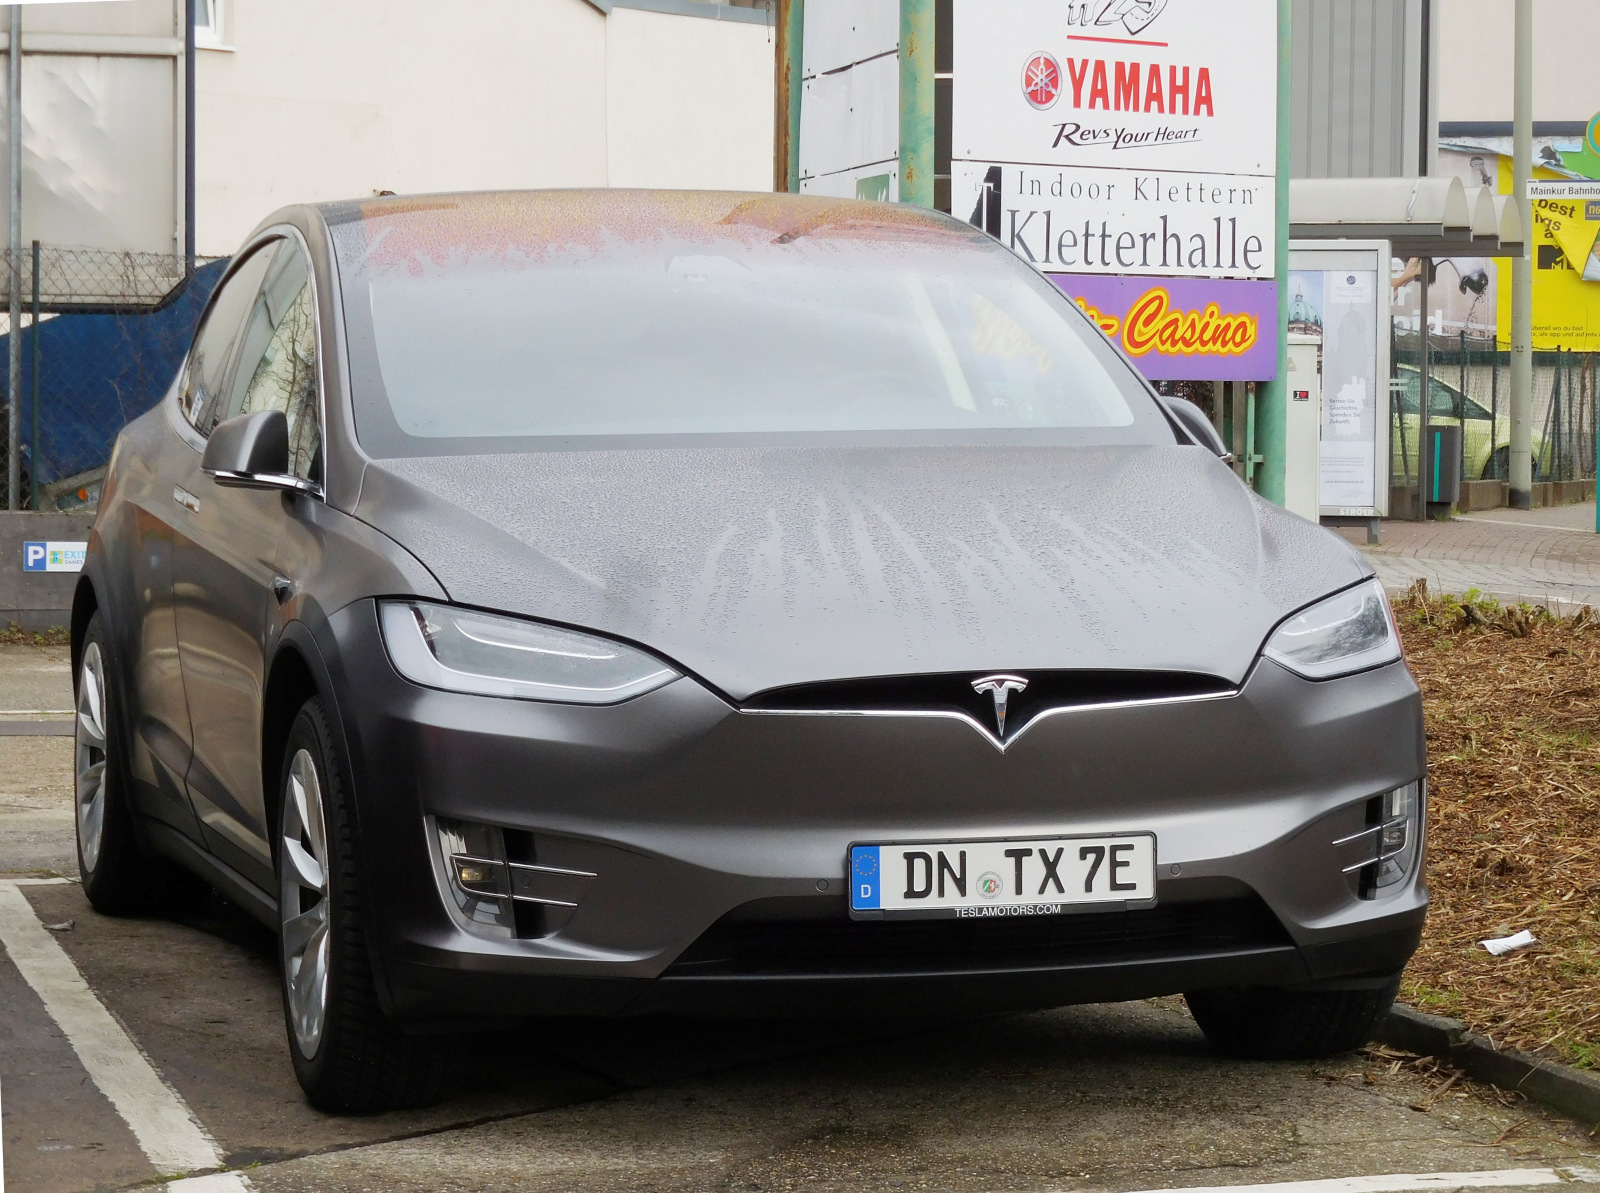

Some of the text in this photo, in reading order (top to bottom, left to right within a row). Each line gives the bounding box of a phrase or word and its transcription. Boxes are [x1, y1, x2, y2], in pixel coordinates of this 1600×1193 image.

[1067, 58, 1214, 117] YAMAHA
[1052, 122, 1201, 150] Revs Your Heart
[1018, 170, 1253, 204] Indoor Klettern
[1531, 187, 1565, 195] Mainkur
[1006, 209, 1263, 271] Kletterhalle
[1124, 290, 1256, 354] Casino
[28, 545, 45, 567] P
[64, 550, 86, 559] EXIT
[903, 850, 967, 899] DN
[1004, 847, 1065, 895] TX
[1079, 843, 1137, 893] 7E
[860, 884, 872, 898] D
[954, 904, 1061, 918] TESLAMOTORS.COM
